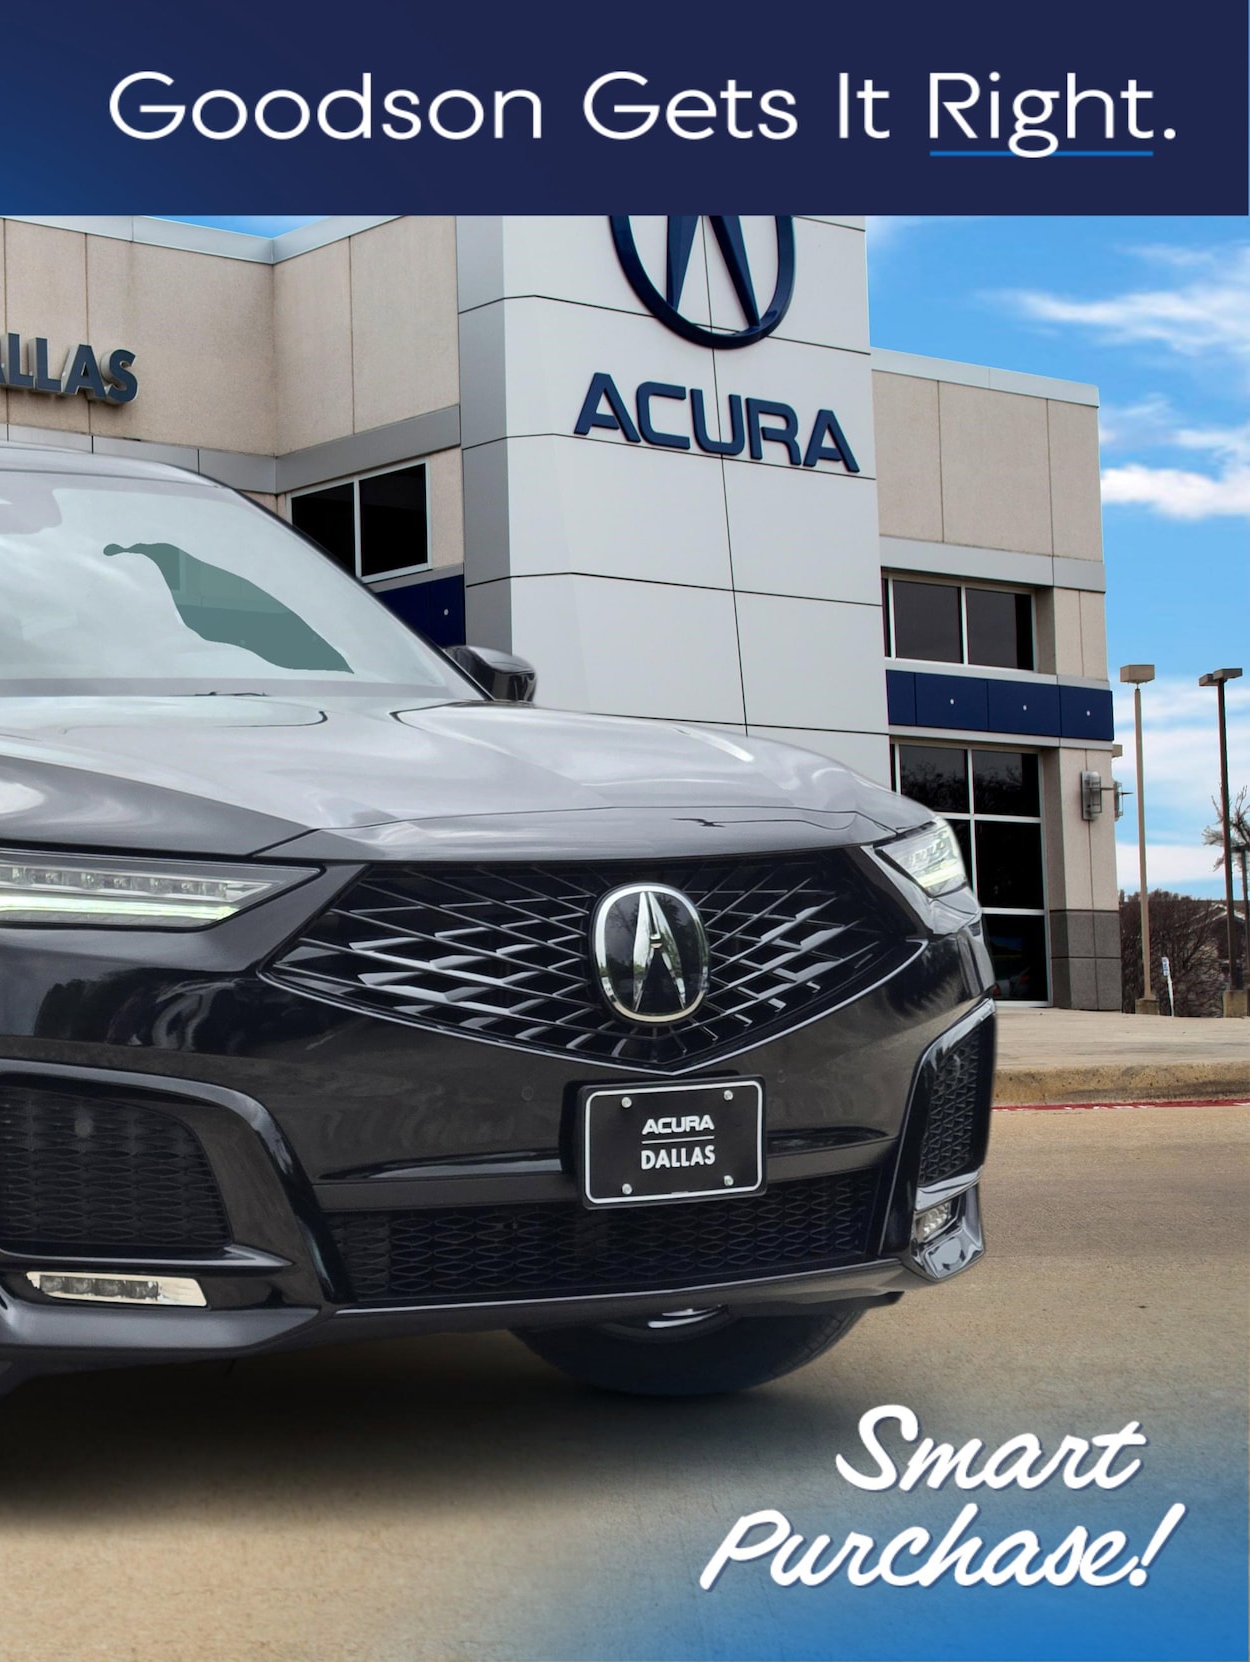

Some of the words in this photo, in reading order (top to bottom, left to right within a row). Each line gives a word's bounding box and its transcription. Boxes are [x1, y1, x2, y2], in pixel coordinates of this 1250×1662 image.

[573, 372, 860, 473] ACURA
[641, 1114, 715, 1135] ACURA
[640, 1144, 716, 1170] DALLAS
